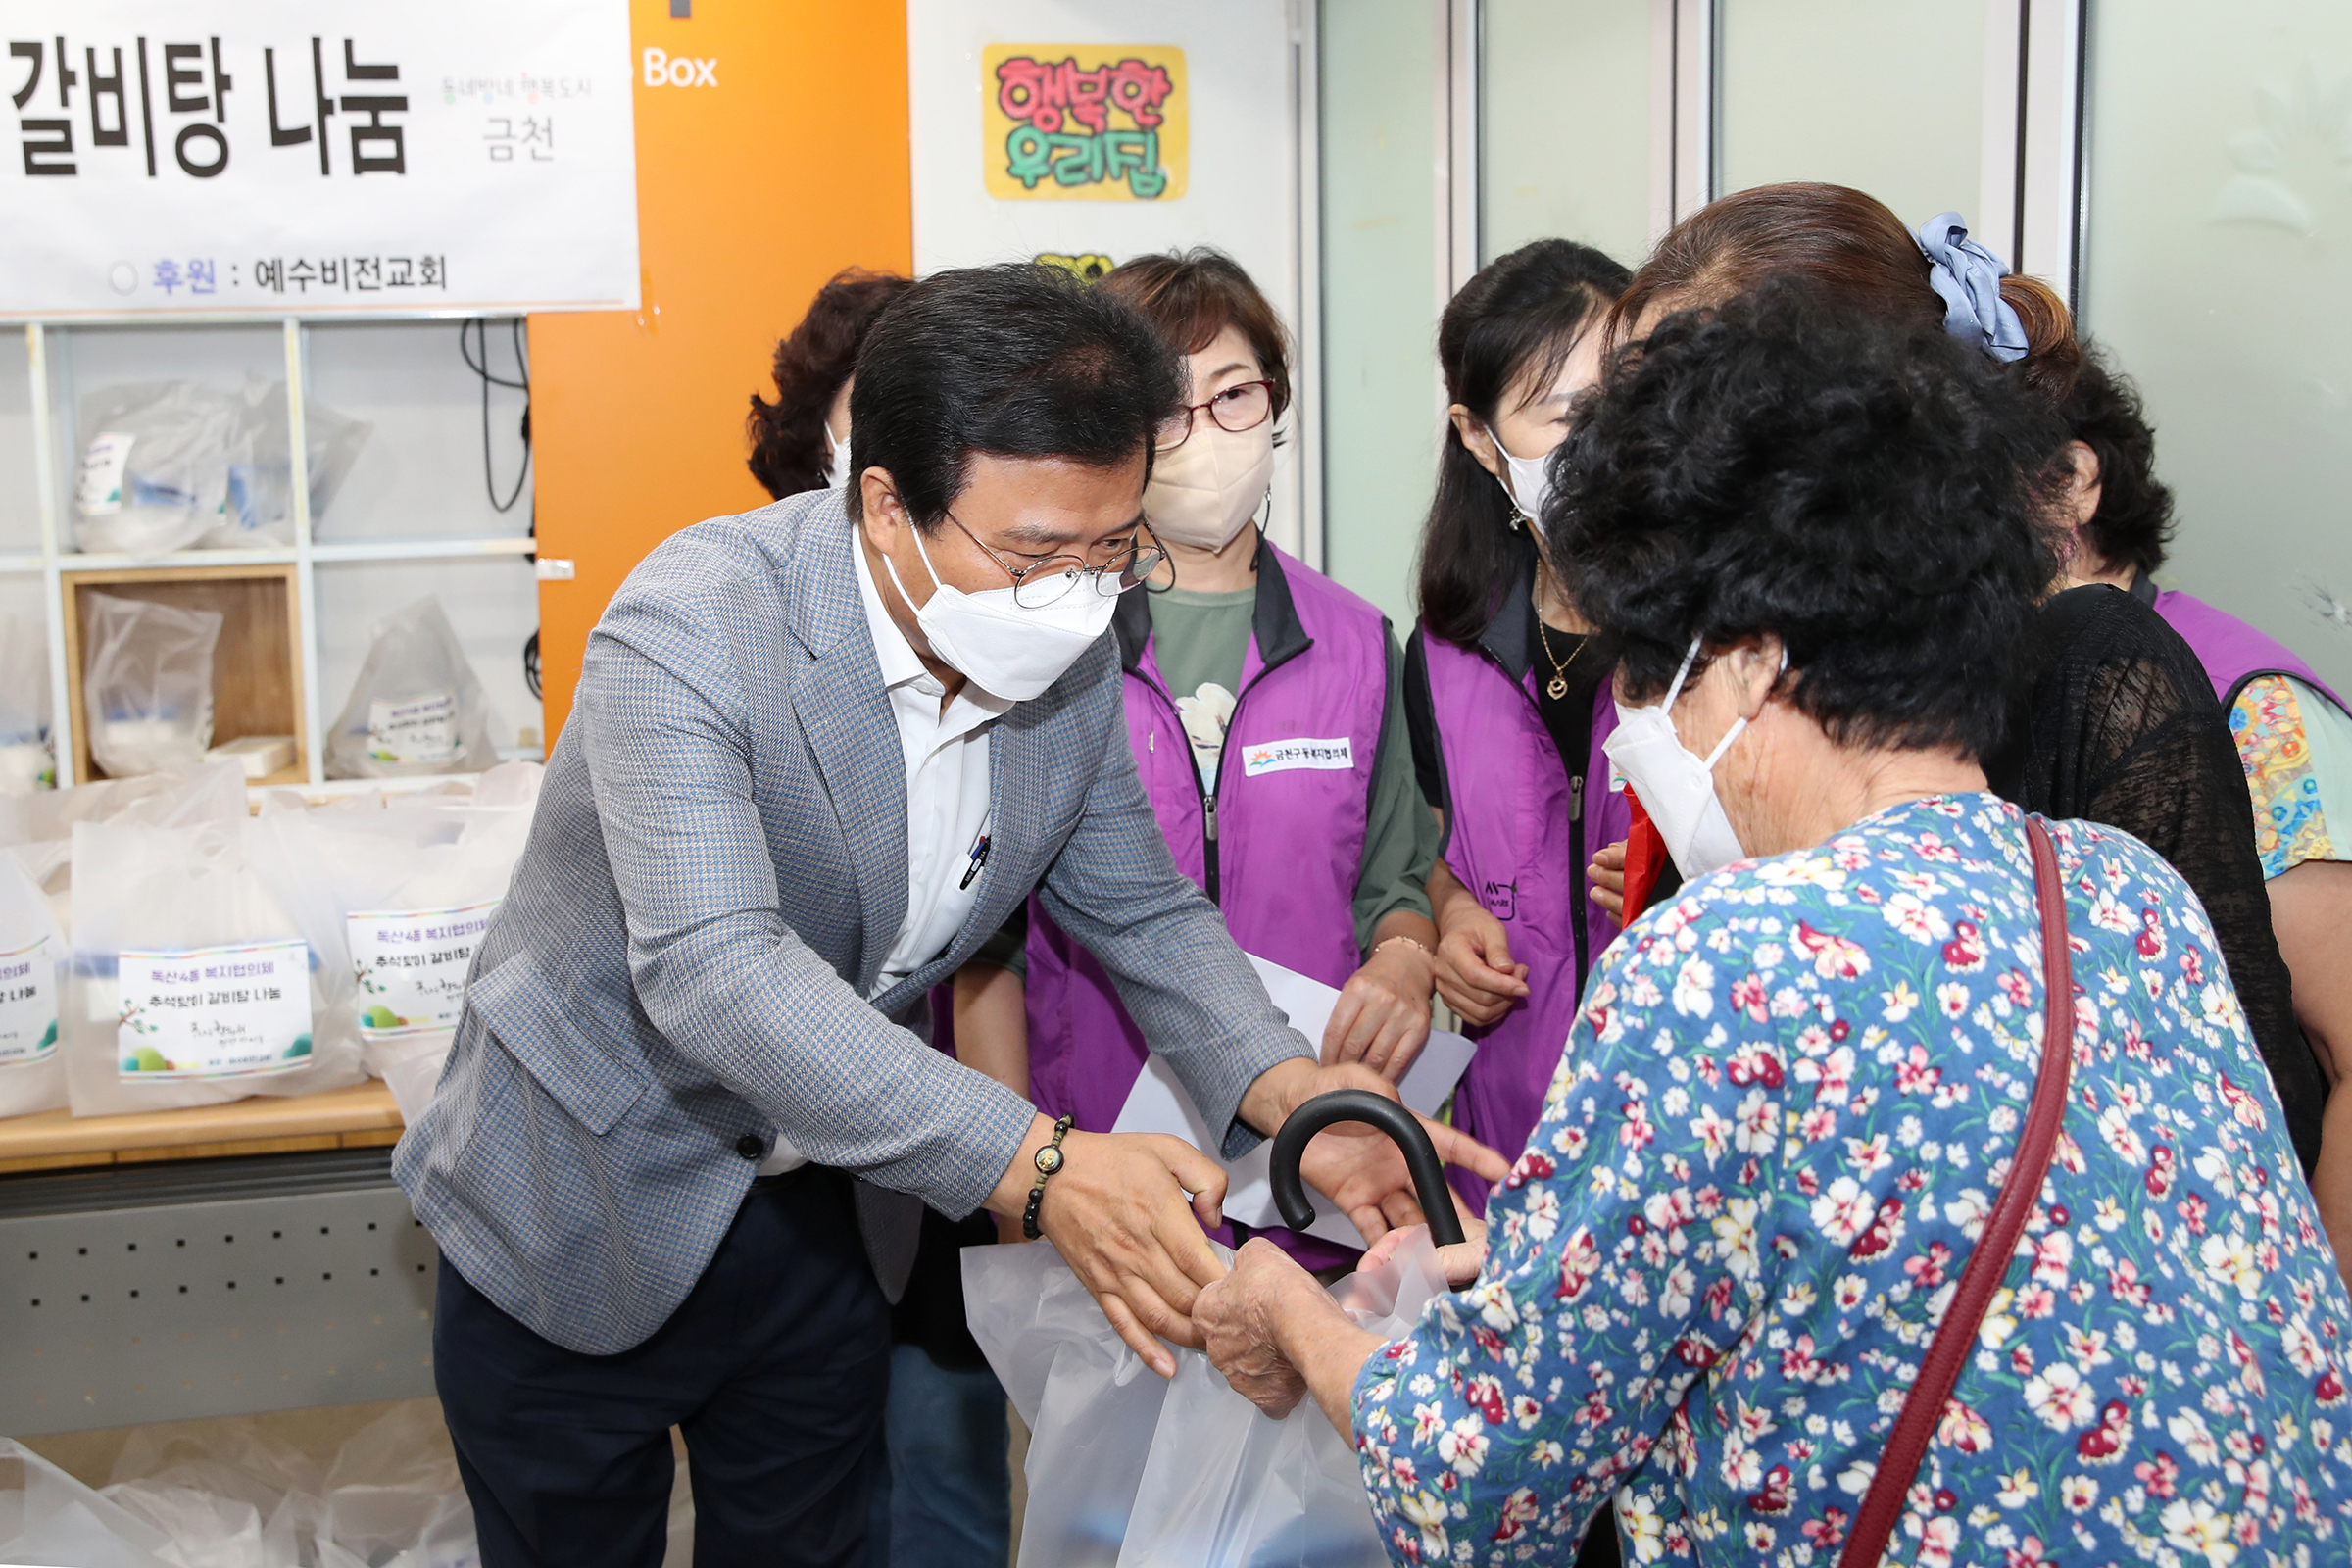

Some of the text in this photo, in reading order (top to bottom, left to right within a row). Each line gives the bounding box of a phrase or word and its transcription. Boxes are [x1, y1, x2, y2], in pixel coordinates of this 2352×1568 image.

[642, 46, 718, 88] Box
[9, 36, 408, 178] 갈비탕 나눔
[996, 57, 1173, 134] 행복한
[483, 115, 555, 162] 금천
[153, 259, 216, 294] 후원
[255, 255, 447, 293] 예수비전교회
